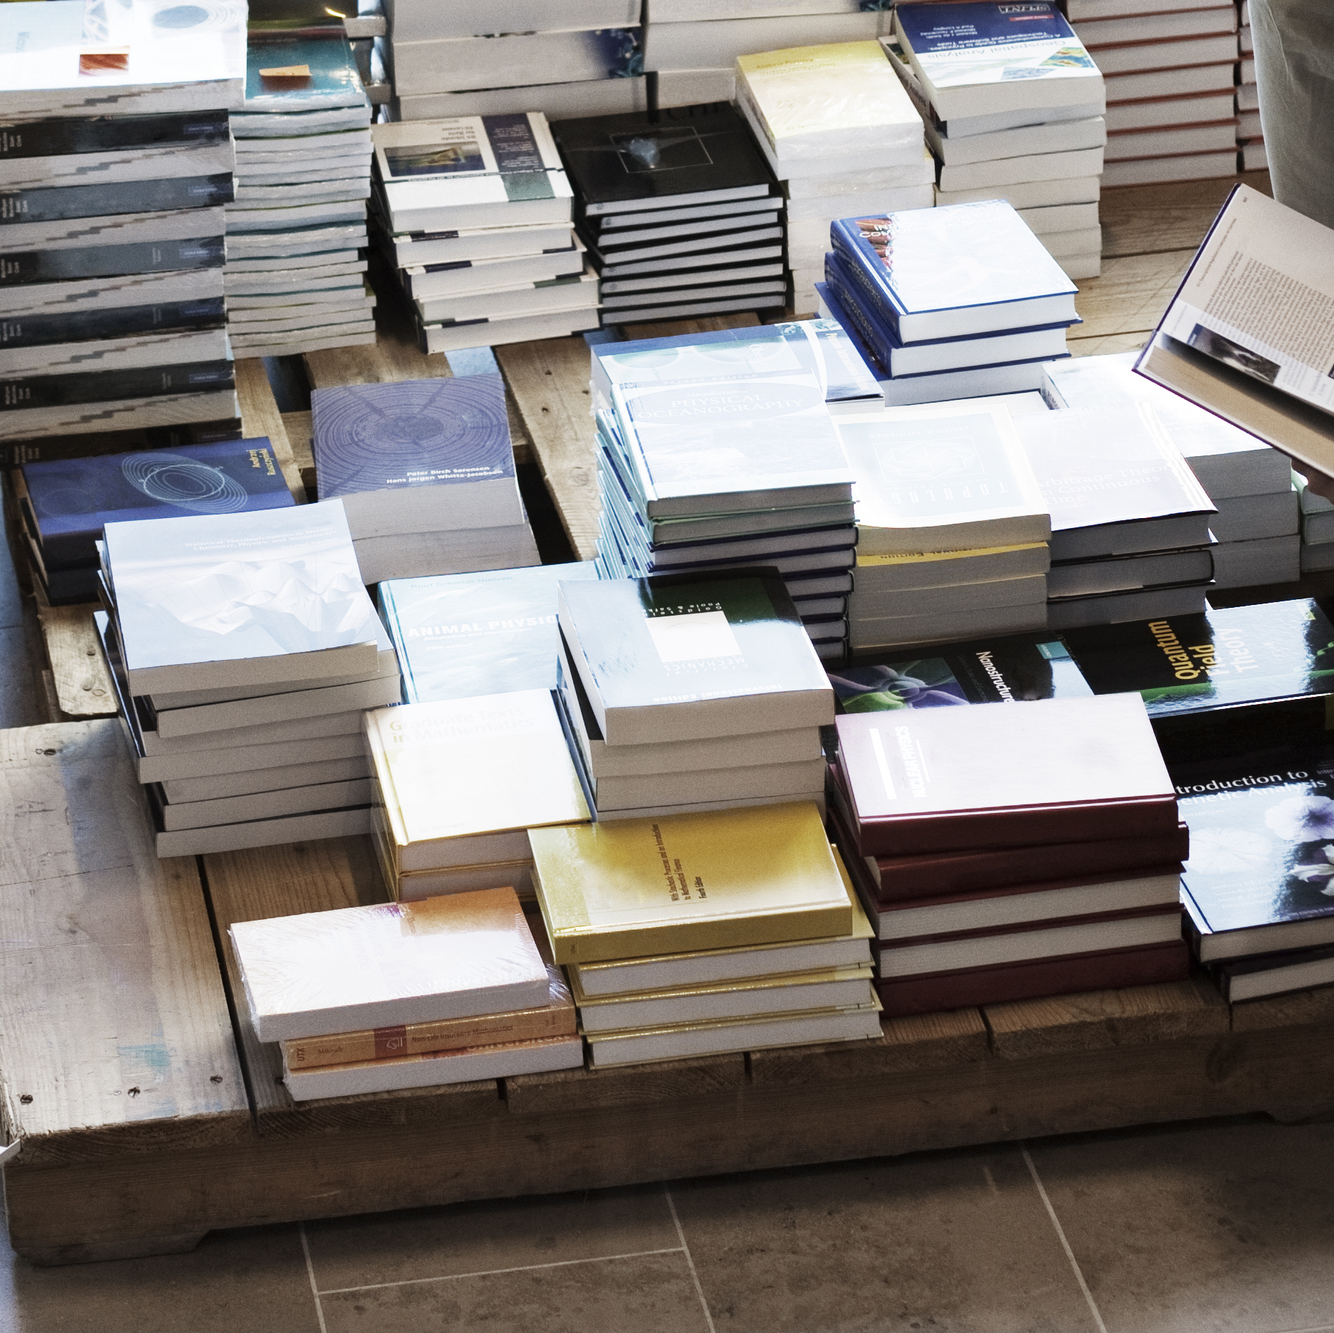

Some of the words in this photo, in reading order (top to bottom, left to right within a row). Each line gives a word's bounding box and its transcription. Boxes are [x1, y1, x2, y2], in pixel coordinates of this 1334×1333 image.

[927, 47, 984, 60] Analysis
[986, 39, 1066, 54] Geospatial
[670, 393, 767, 409] PHYSICAL
[687, 389, 739, 398] Introduction
[638, 399, 803, 419] OCEANOGRAPHY
[437, 470, 504, 480] Whitta-Jacobsen
[1115, 464, 1170, 478] Theor
[887, 481, 1009, 505] TOPOLOG
[1058, 474, 1161, 495] Continuous
[1046, 494, 1086, 506] Time
[184, 540, 224, 548] Statistical
[226, 532, 294, 544] Thermodynamics
[193, 543, 237, 551] Chemistry,
[408, 622, 482, 638] ANIMAL
[489, 615, 558, 630] PHYSIO
[1148, 620, 1194, 681] Quantum
[1216, 627, 1260, 674] Theory
[663, 656, 745, 672] MECHANICS
[389, 713, 474, 732] Graduate
[478, 707, 525, 720] Texts
[393, 733, 410, 744] in
[416, 717, 535, 741] Mathematics
[895, 726, 918, 761] PHYSICS
[904, 761, 927, 797] NUCLEAR
[1176, 772, 1282, 794] troduction
[1287, 770, 1308, 780] to
[1180, 790, 1243, 806] enetic
[1247, 777, 1327, 799] Analysis
[296, 1046, 306, 1062] UTX
